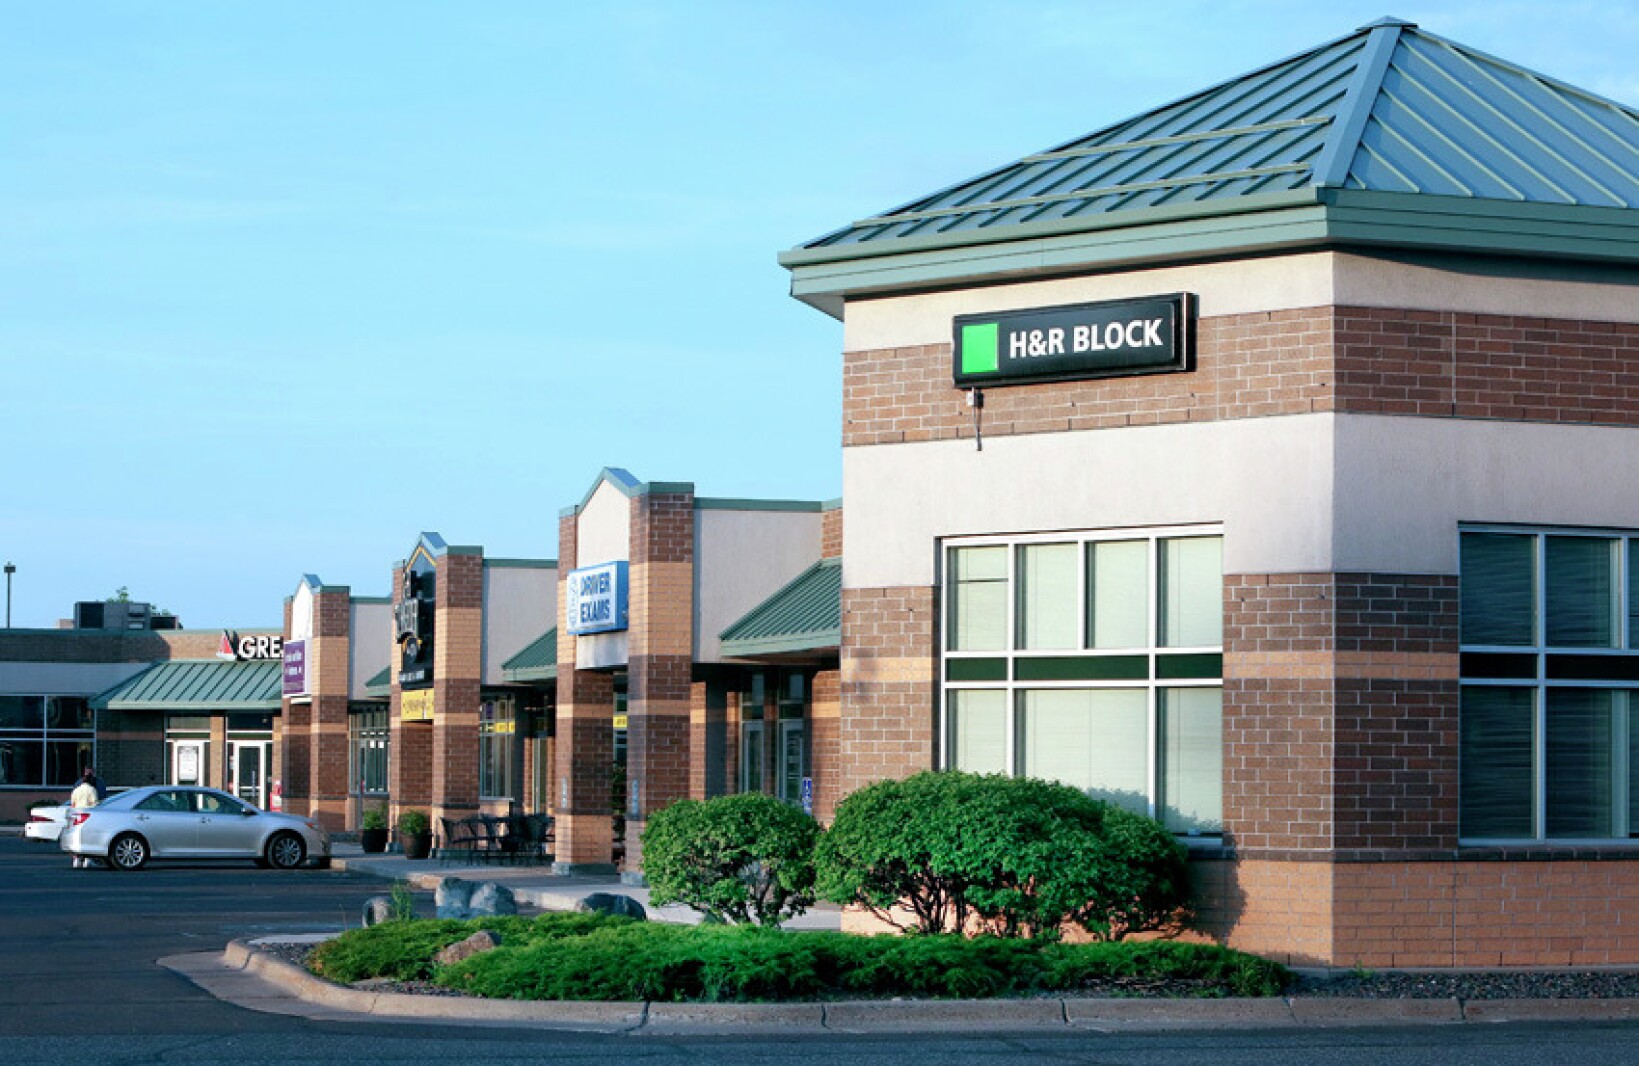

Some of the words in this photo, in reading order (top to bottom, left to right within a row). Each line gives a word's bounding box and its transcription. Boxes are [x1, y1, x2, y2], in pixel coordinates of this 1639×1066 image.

[1009, 327, 1065, 360] H&R
[1073, 317, 1164, 353] BLOCK
[580, 571, 611, 596] DRIVER
[580, 599, 610, 623] EXAMS
[238, 635, 284, 659] GRE
